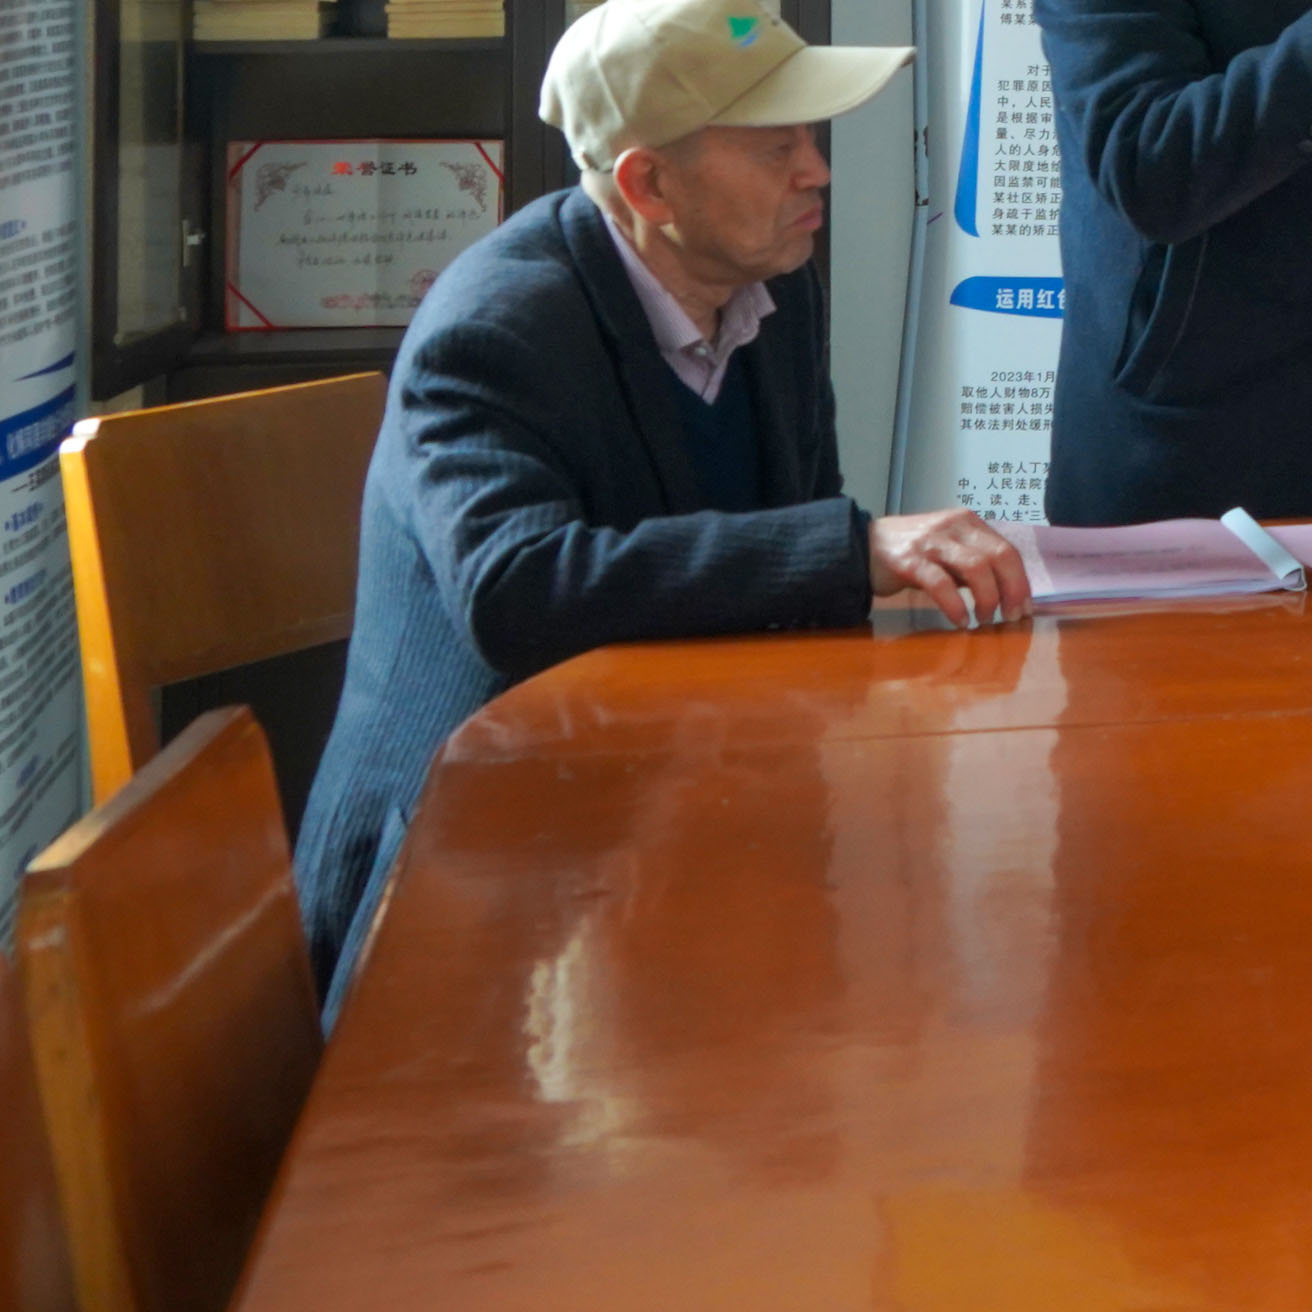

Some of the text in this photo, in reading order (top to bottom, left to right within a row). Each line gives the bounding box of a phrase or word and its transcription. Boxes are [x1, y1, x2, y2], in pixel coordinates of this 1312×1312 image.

[990, 370, 1056, 383] 2023年1月
[958, 477, 1048, 490] 中，人民法院
